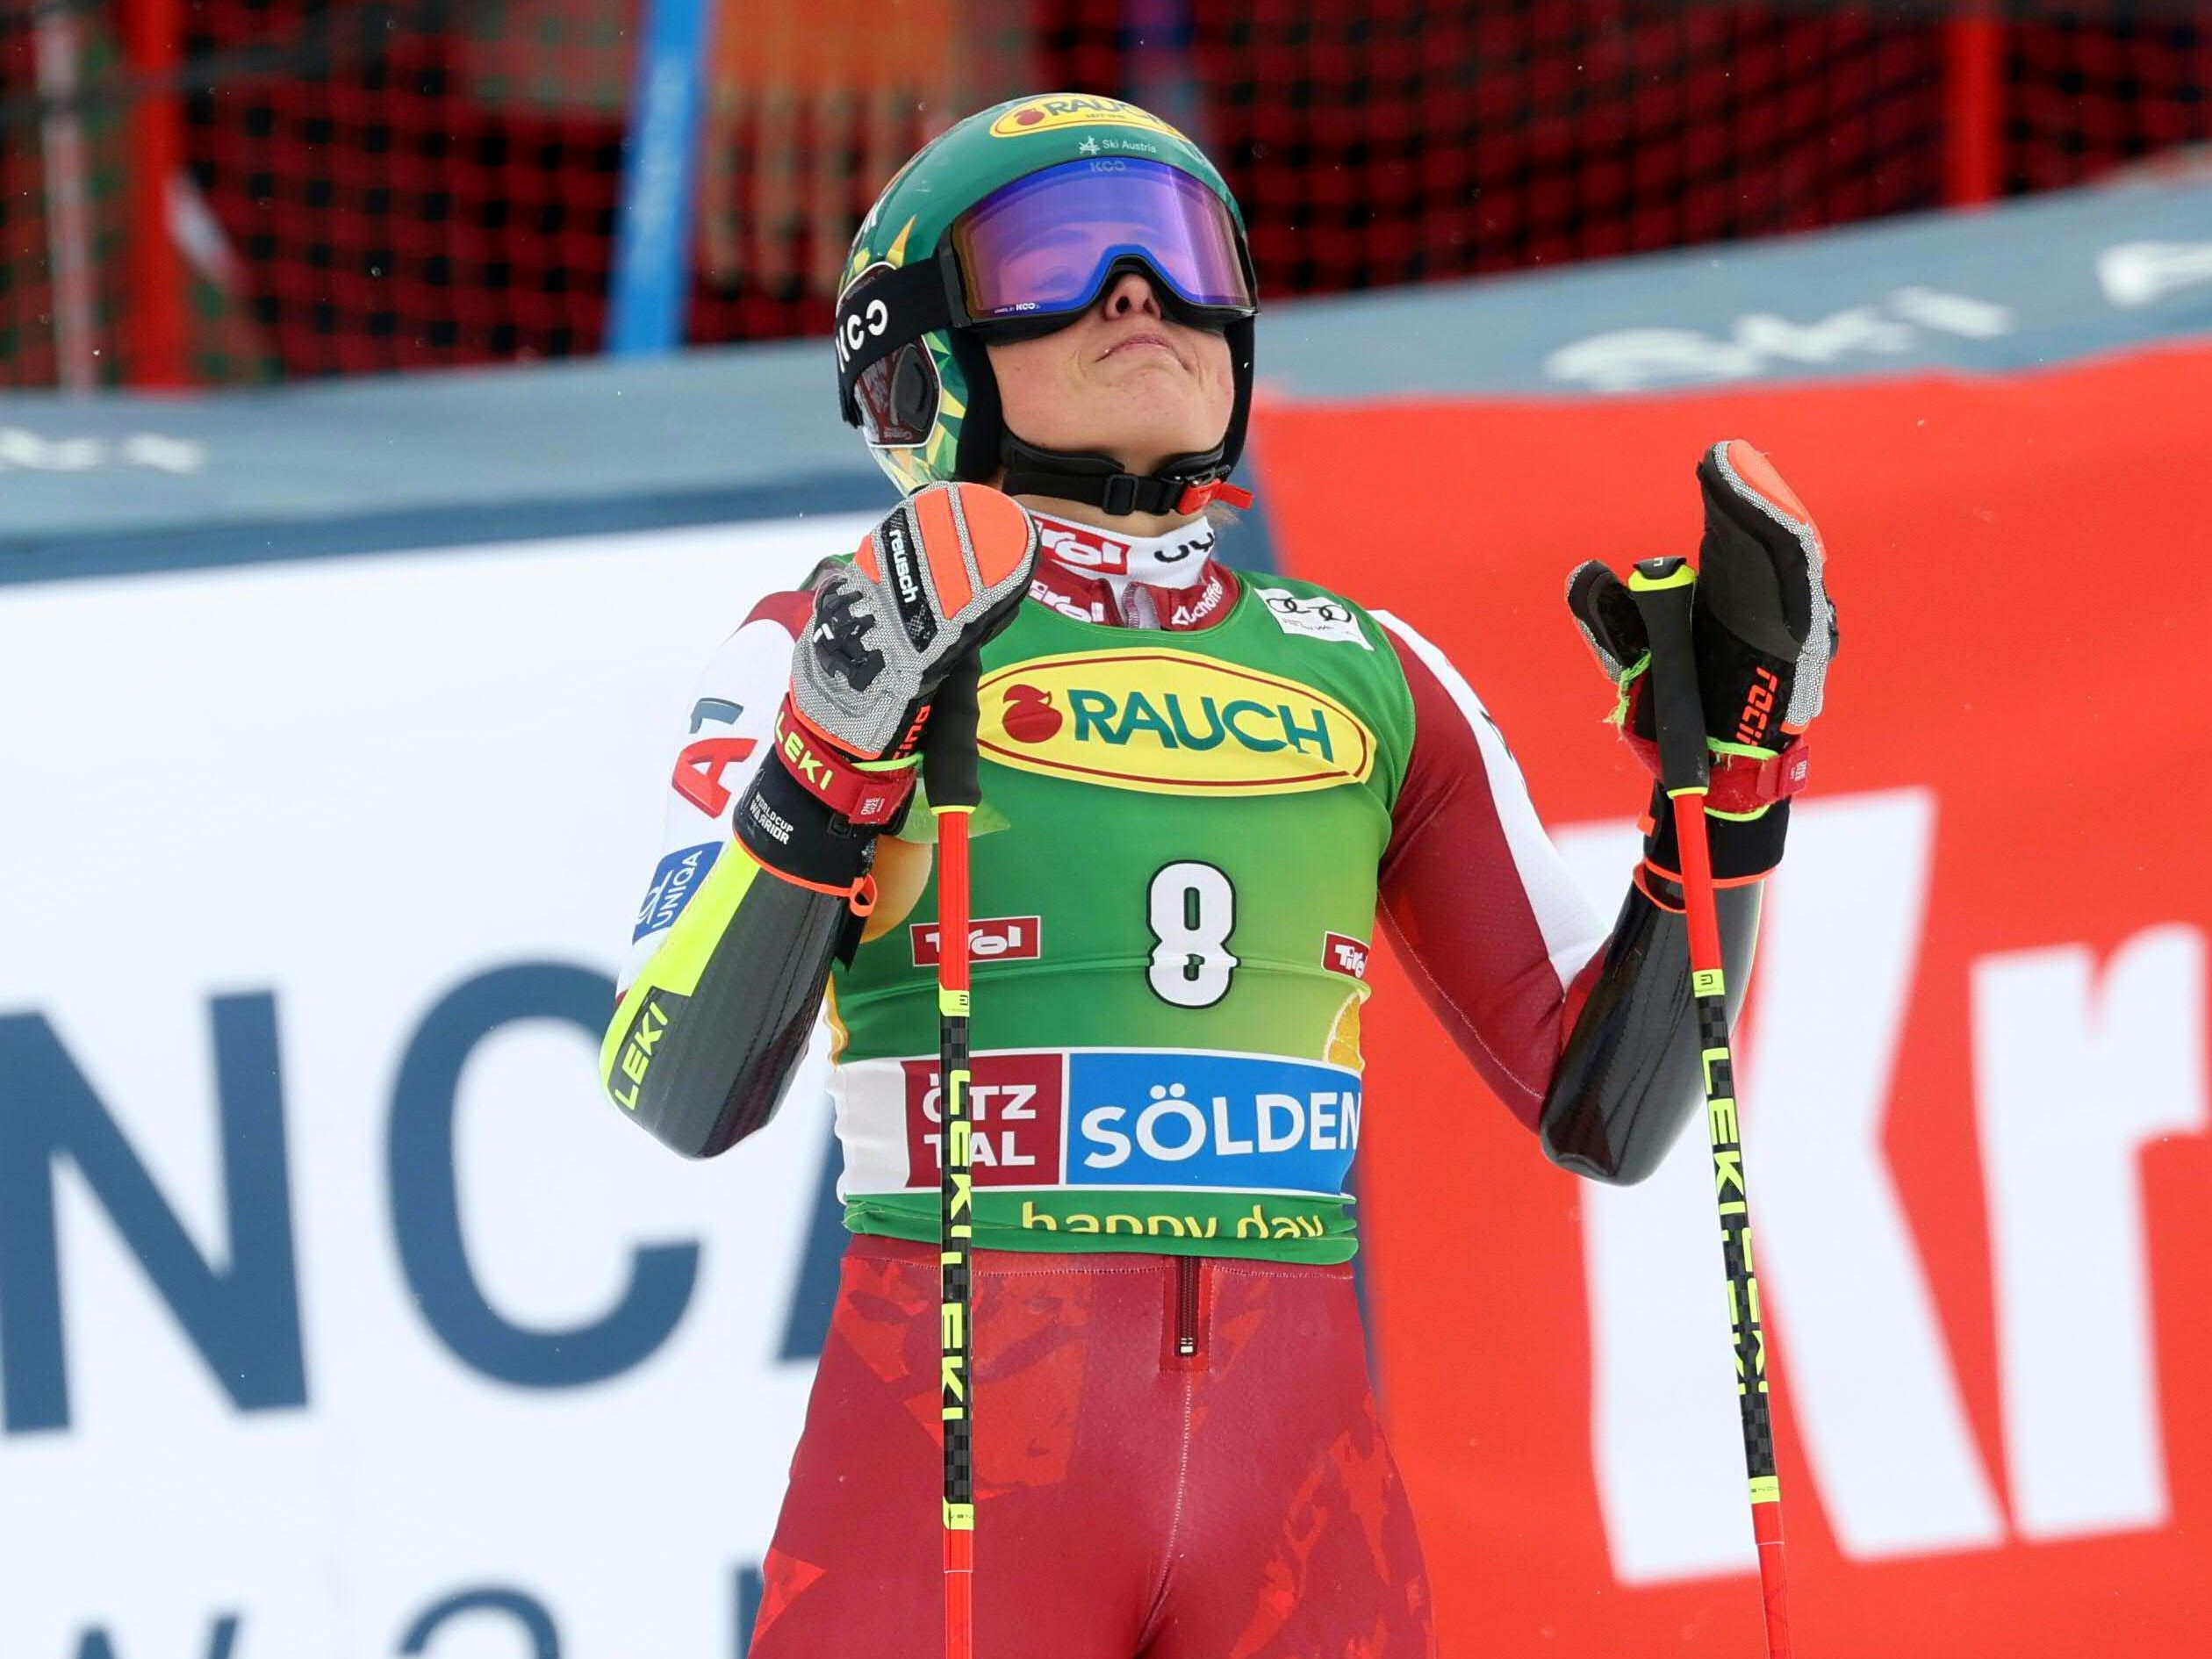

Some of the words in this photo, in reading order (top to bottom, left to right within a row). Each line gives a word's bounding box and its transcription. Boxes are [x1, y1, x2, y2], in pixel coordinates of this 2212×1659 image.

[1044, 97, 1160, 124] RAUC
[1102, 140, 1119, 149] Ski
[1122, 140, 1157, 154] Austria
[889, 528, 919, 604] reusch
[1033, 520, 1123, 565] rol
[1029, 579, 1105, 624] irol
[775, 710, 834, 791] LEKI
[1067, 689, 1334, 764] RAUCH
[750, 799, 790, 845] WARRIOR
[755, 791, 794, 833] WORLDCUP
[651, 850, 703, 929] UNIQA
[925, 924, 1022, 955] rol
[1146, 859, 1241, 1009] 8
[1334, 944, 1368, 979] Tiro
[614, 1001, 669, 1110] LEKI
[949, 1069, 973, 1238] LEKI
[1081, 1082, 1361, 1170] SÖLDEN
[1701, 1046, 1746, 1216] LEKI
[0, 957, 838, 1440] NC
